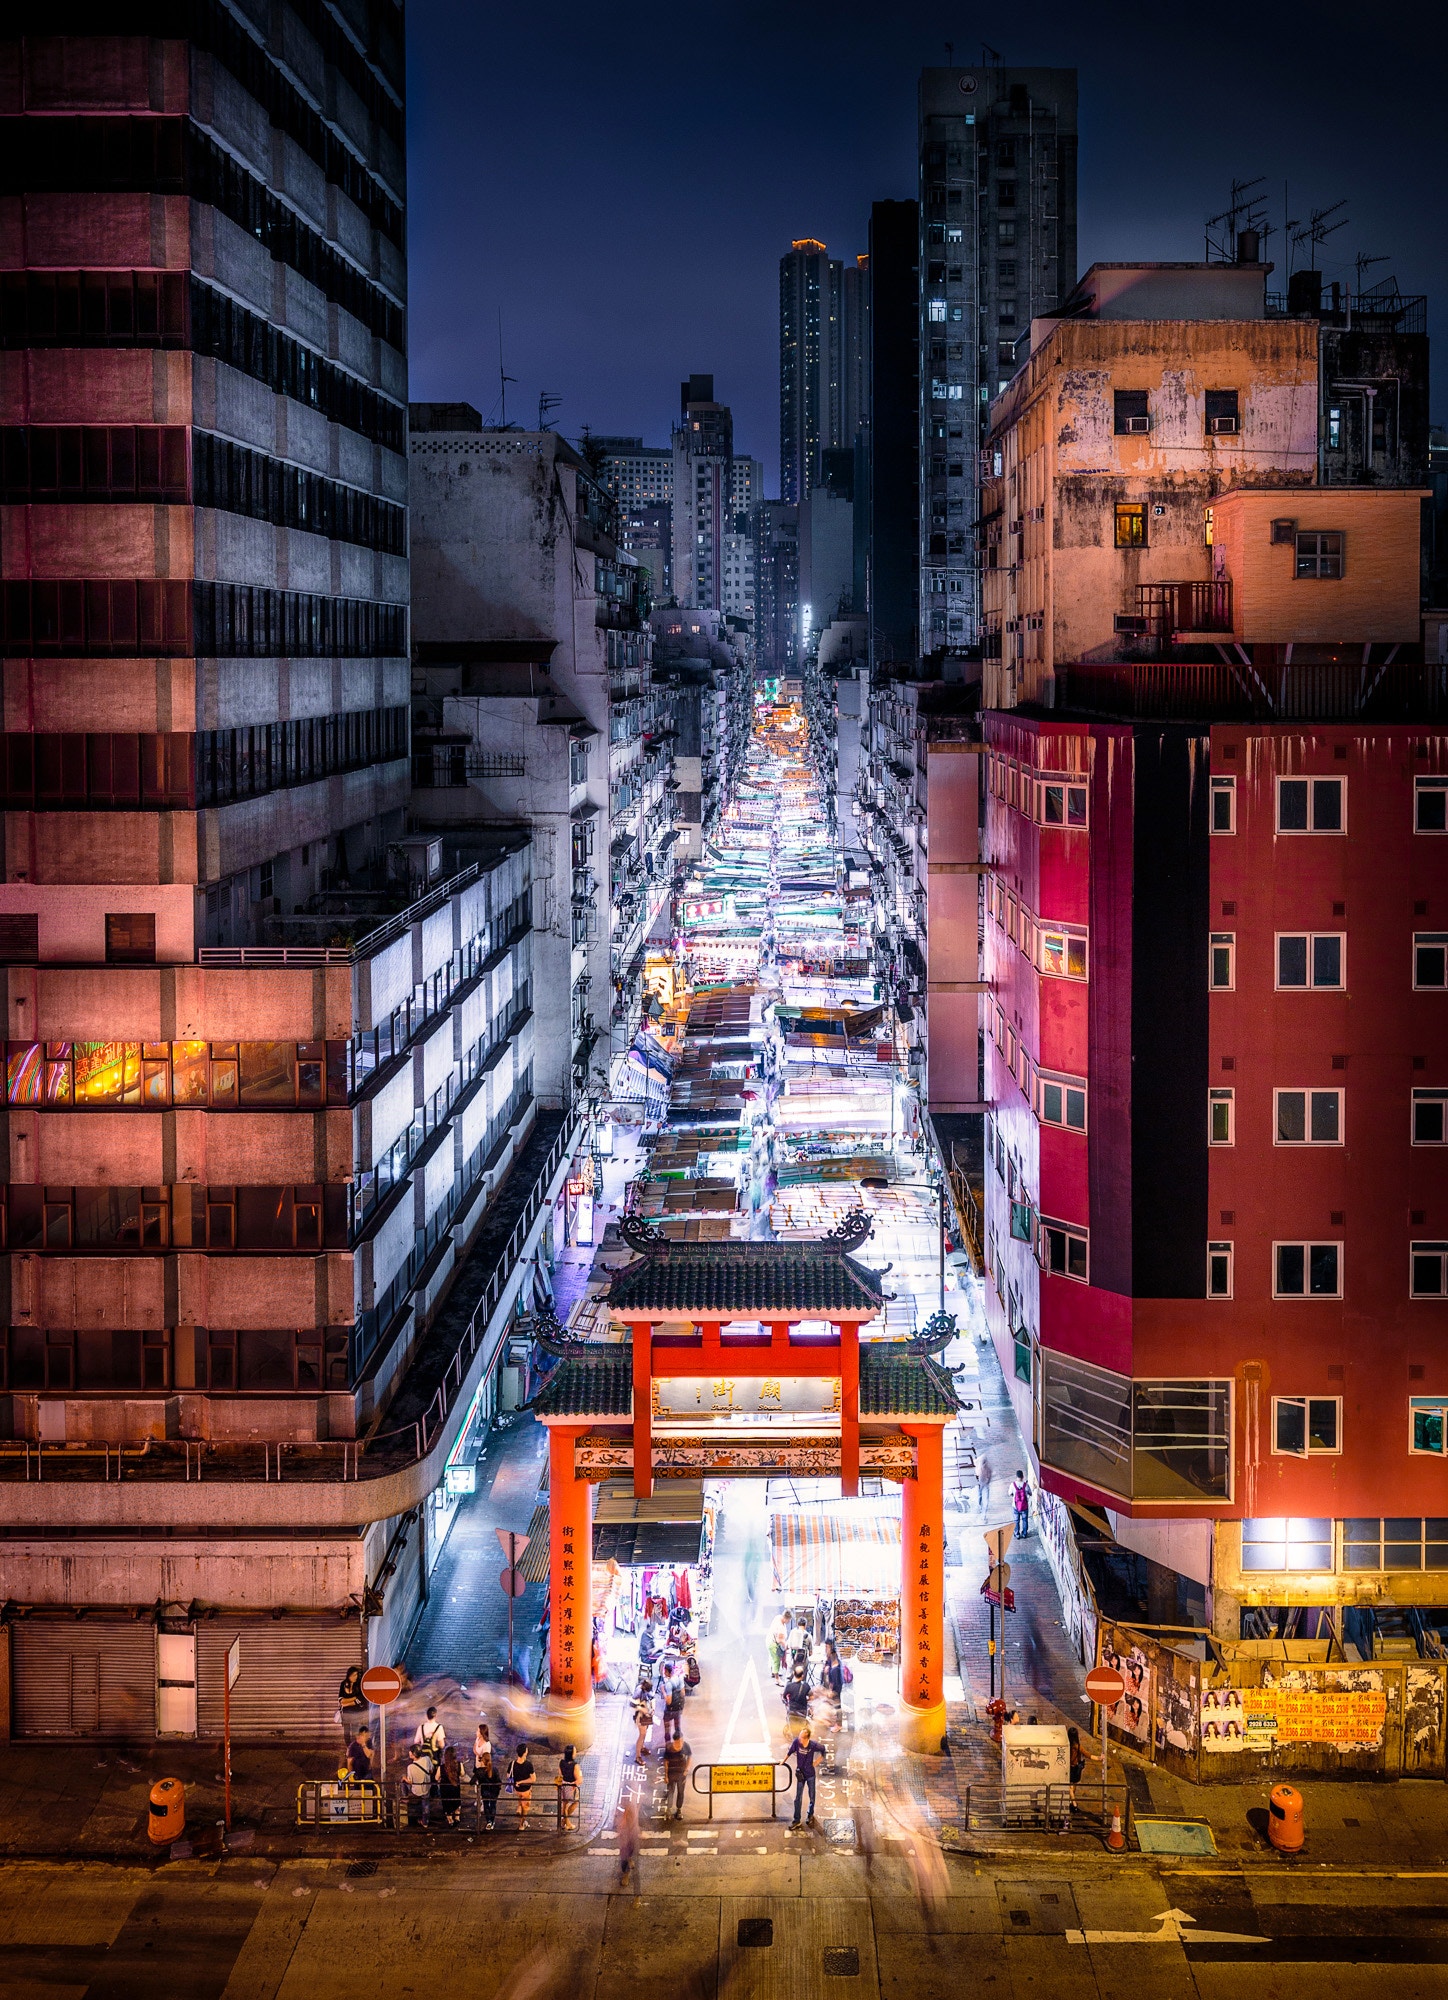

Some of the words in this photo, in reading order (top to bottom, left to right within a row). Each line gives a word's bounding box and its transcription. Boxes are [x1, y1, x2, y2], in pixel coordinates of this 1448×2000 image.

[711, 1403, 743, 1412] Temple
[757, 1403, 783, 1411] Street
[1250, 1698, 1262, 1709] 2366
[1286, 1704, 1298, 1713] 2366
[1322, 1705, 1334, 1714] 2366
[1358, 1704, 1370, 1713] 2366
[1286, 1728, 1298, 1737] 2366
[1322, 1729, 1334, 1738] 2366
[1357, 1729, 1369, 1738] 2366
[618, 1764, 648, 1804] 望左
